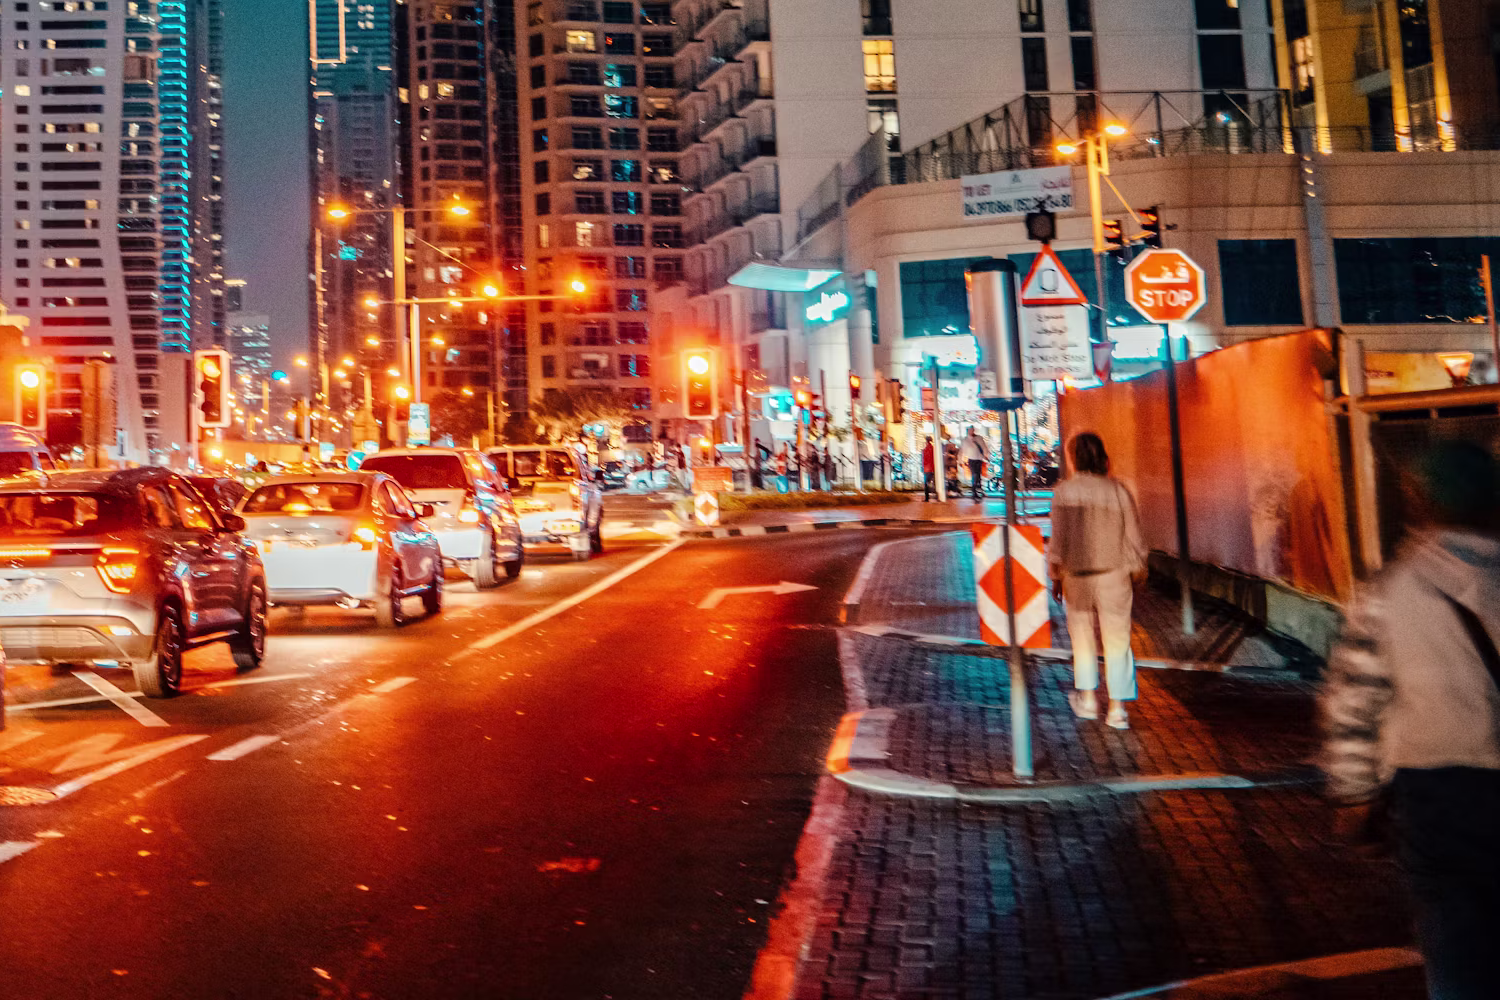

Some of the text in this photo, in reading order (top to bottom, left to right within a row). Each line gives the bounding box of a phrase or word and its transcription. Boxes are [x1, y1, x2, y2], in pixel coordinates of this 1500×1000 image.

[1139, 261, 1190, 284] قف
[1139, 289, 1193, 307] STOP
[1061, 354, 1087, 363] Stop
